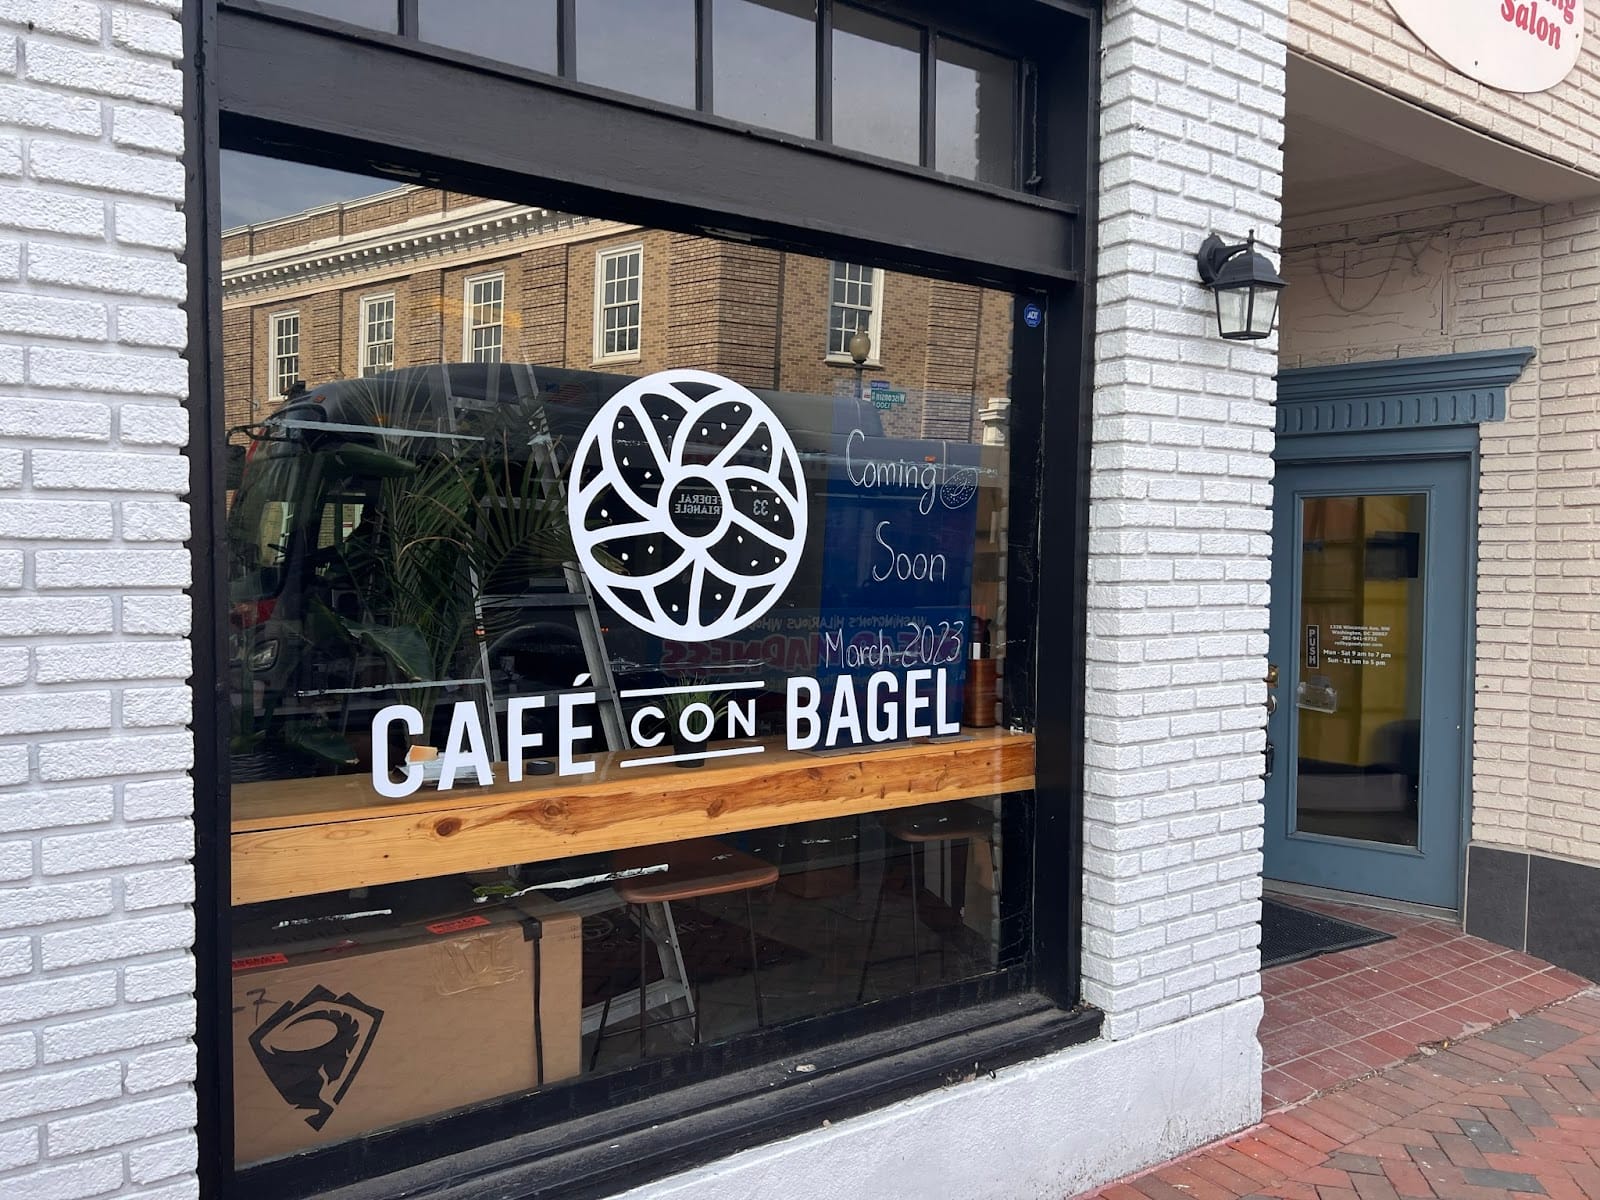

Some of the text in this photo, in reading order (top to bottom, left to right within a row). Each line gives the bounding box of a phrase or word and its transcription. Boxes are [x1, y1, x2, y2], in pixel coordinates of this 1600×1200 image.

[1501, 0, 1561, 50] Salon
[846, 429, 937, 515] Coming
[872, 521, 946, 582] Soon
[901, 620, 965, 668] 2023
[371, 673, 596, 798] CAFÉ
[786, 667, 961, 751] BAGEL
